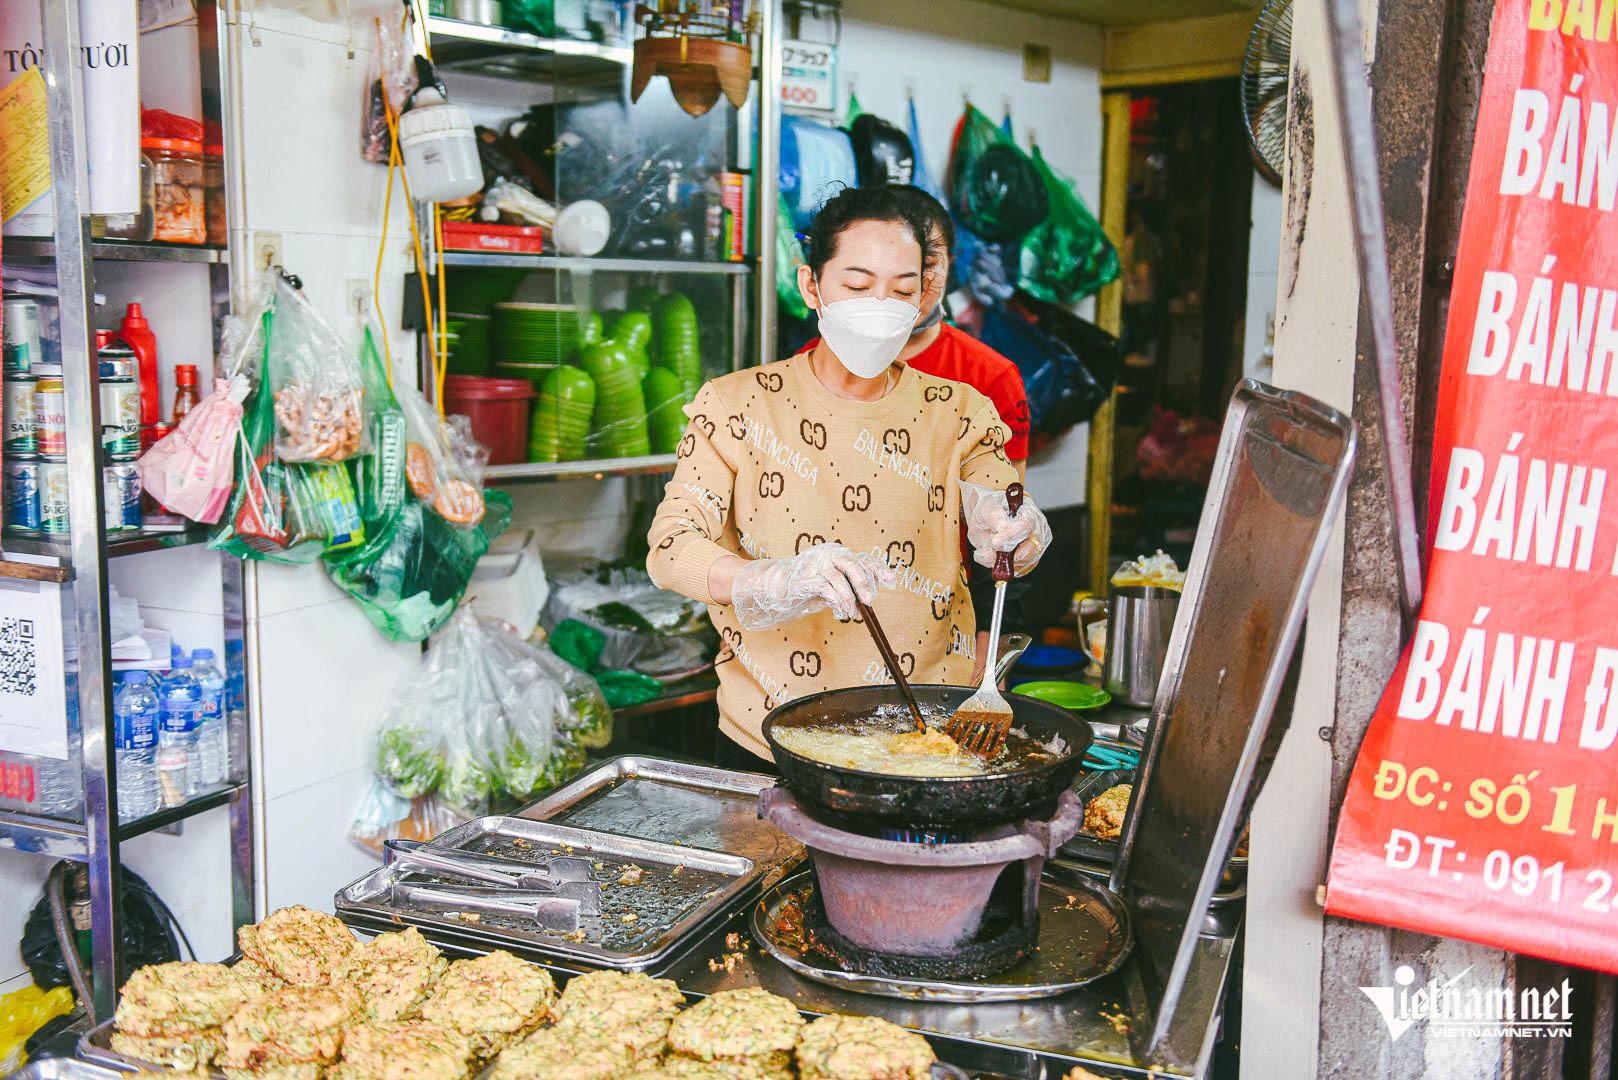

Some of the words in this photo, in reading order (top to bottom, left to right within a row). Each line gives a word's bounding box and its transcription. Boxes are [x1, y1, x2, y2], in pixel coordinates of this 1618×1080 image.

[3, 42, 45, 73] TÔ
[80, 42, 129, 69] ƯƠI
[1434, 432, 1607, 571] BÁNH
[1398, 605, 1576, 744] BÁNH
[1374, 759, 1452, 811] ĐC:
[1464, 769, 1541, 825] SỐ
[1541, 783, 1577, 836] 1
[1384, 828, 1467, 882] ĐT:
[1483, 849, 1565, 903] 091
[1581, 868, 1618, 913] 2
